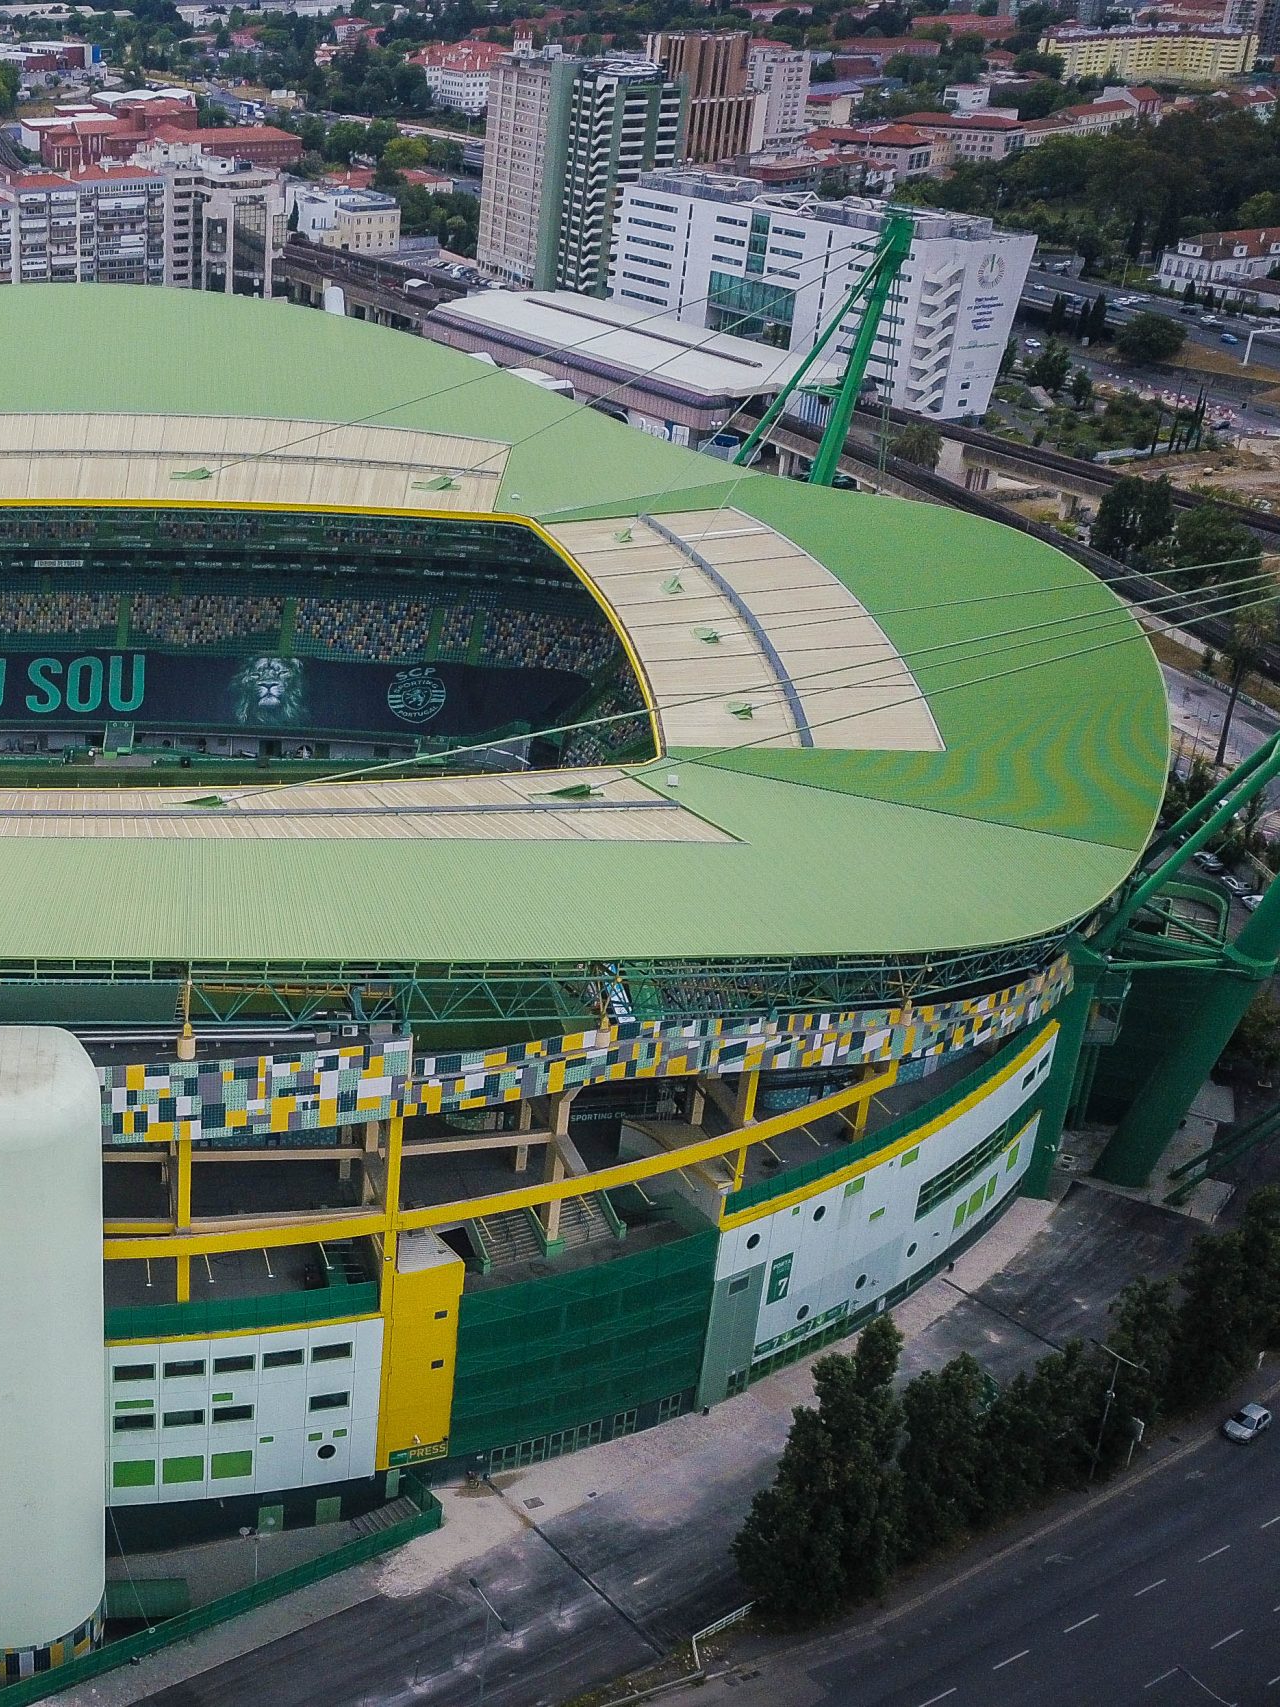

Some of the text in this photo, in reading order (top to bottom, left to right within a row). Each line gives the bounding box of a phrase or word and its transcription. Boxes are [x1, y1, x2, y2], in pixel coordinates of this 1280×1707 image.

[395, 667, 437, 681] SCP
[25, 654, 146, 713] SOU
[393, 680, 439, 694] SPORTING
[397, 705, 439, 718] PORTUGAL
[570, 1112, 613, 1122] SPORTING
[778, 1277, 789, 1297] 7
[410, 1444, 446, 1459] PRESS
